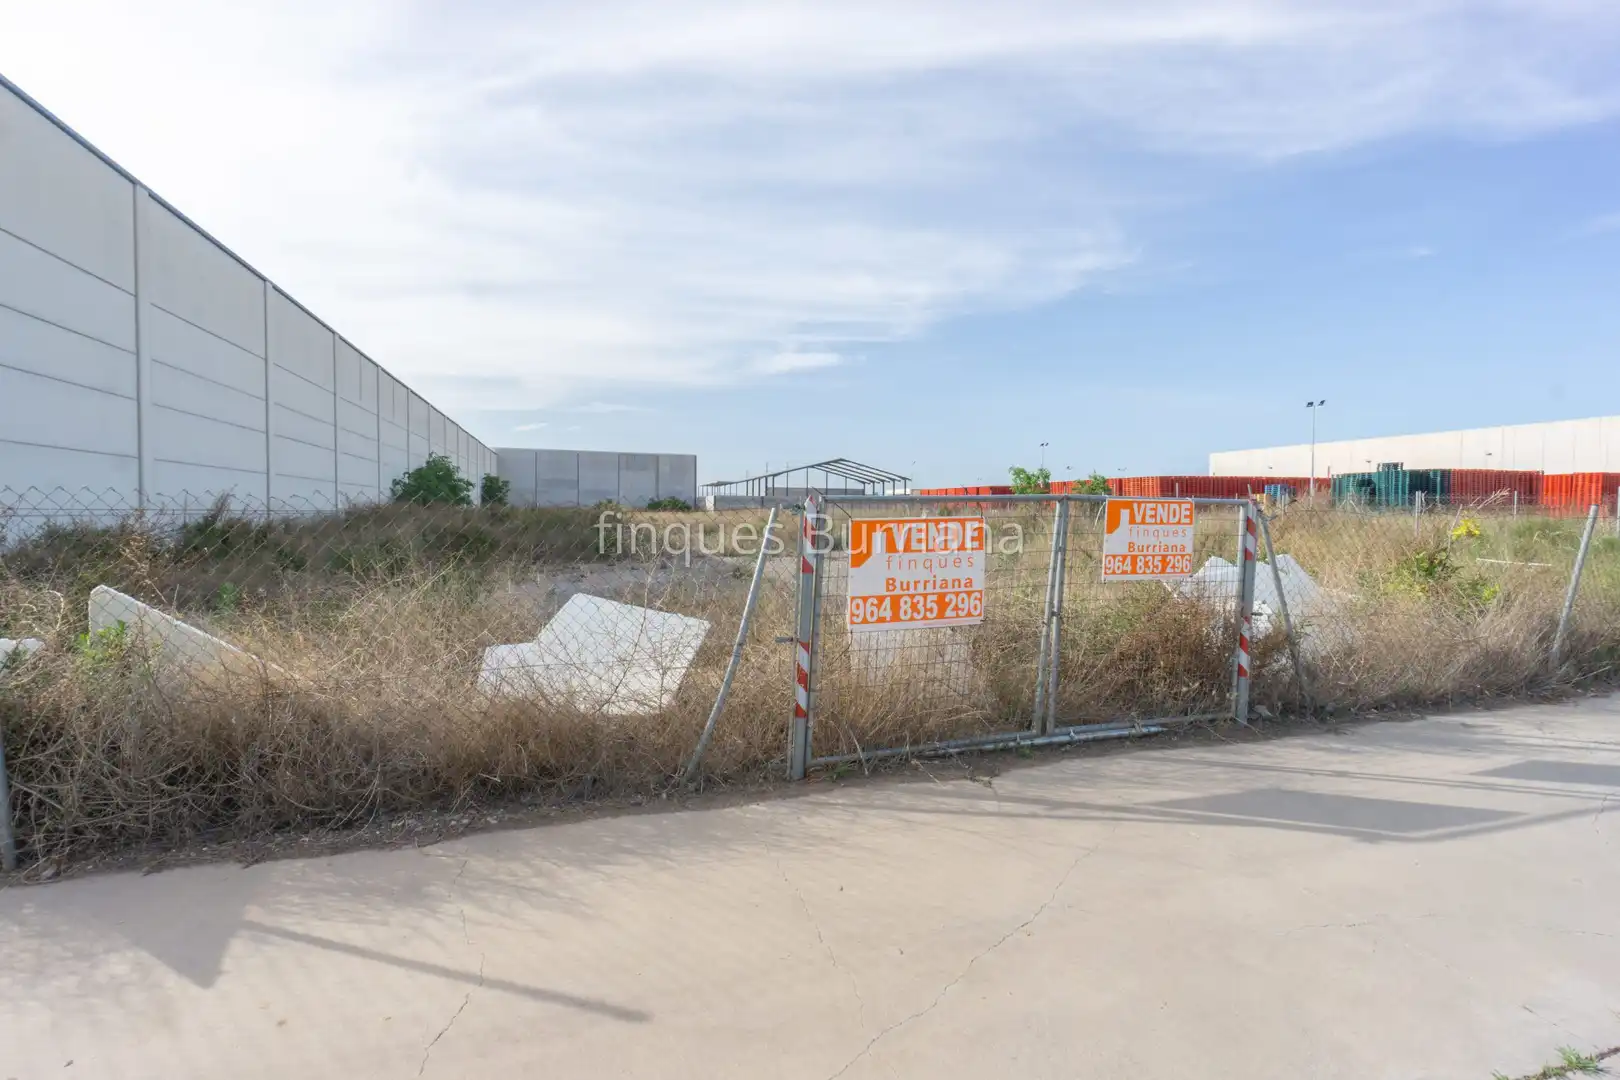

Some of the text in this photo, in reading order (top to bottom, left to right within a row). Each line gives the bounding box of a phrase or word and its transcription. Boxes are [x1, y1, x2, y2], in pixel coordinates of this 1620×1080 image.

[1133, 503, 1190, 523] VENDE
[891, 521, 981, 550] VENDE
[1129, 526, 1187, 540] finques
[1128, 541, 1186, 552] Burriana
[886, 555, 974, 573] finques
[1105, 555, 1191, 573] 964 835 296
[885, 575, 973, 593] Burriana
[851, 592, 982, 623] 964 835 296
